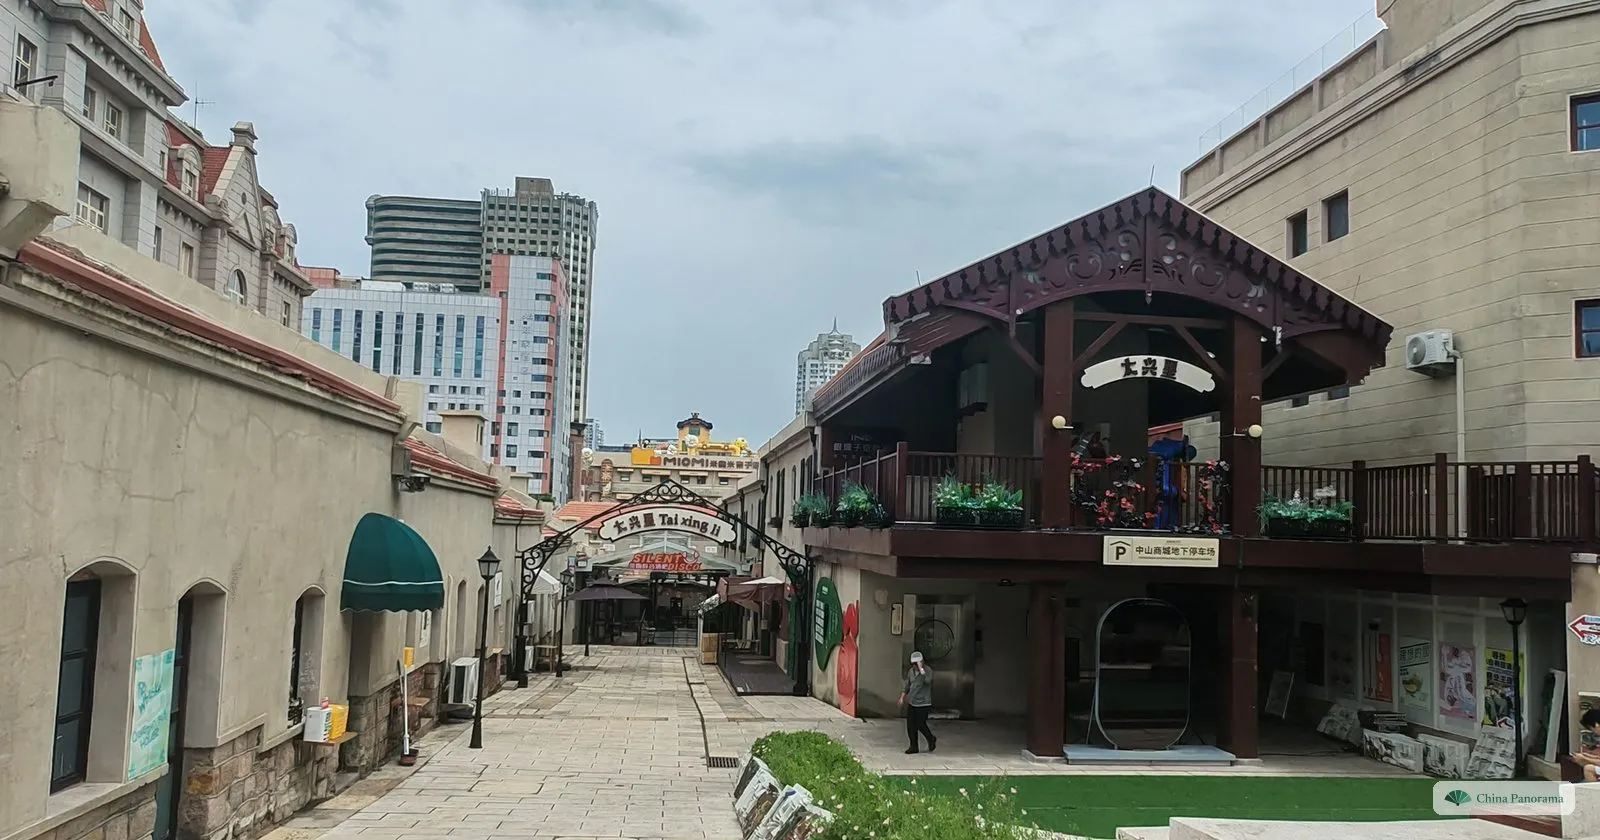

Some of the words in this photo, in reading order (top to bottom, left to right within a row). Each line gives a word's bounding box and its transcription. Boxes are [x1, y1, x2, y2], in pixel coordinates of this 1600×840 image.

[663, 456, 709, 468] MIOMI
[659, 512, 678, 526] Tai
[681, 515, 709, 534] xing
[710, 523, 722, 537] li
[1115, 546, 1126, 560] P
[1135, 545, 1216, 557] 中山商城地下停车场
[633, 553, 682, 564] SILENT
[667, 562, 700, 571] DISCO
